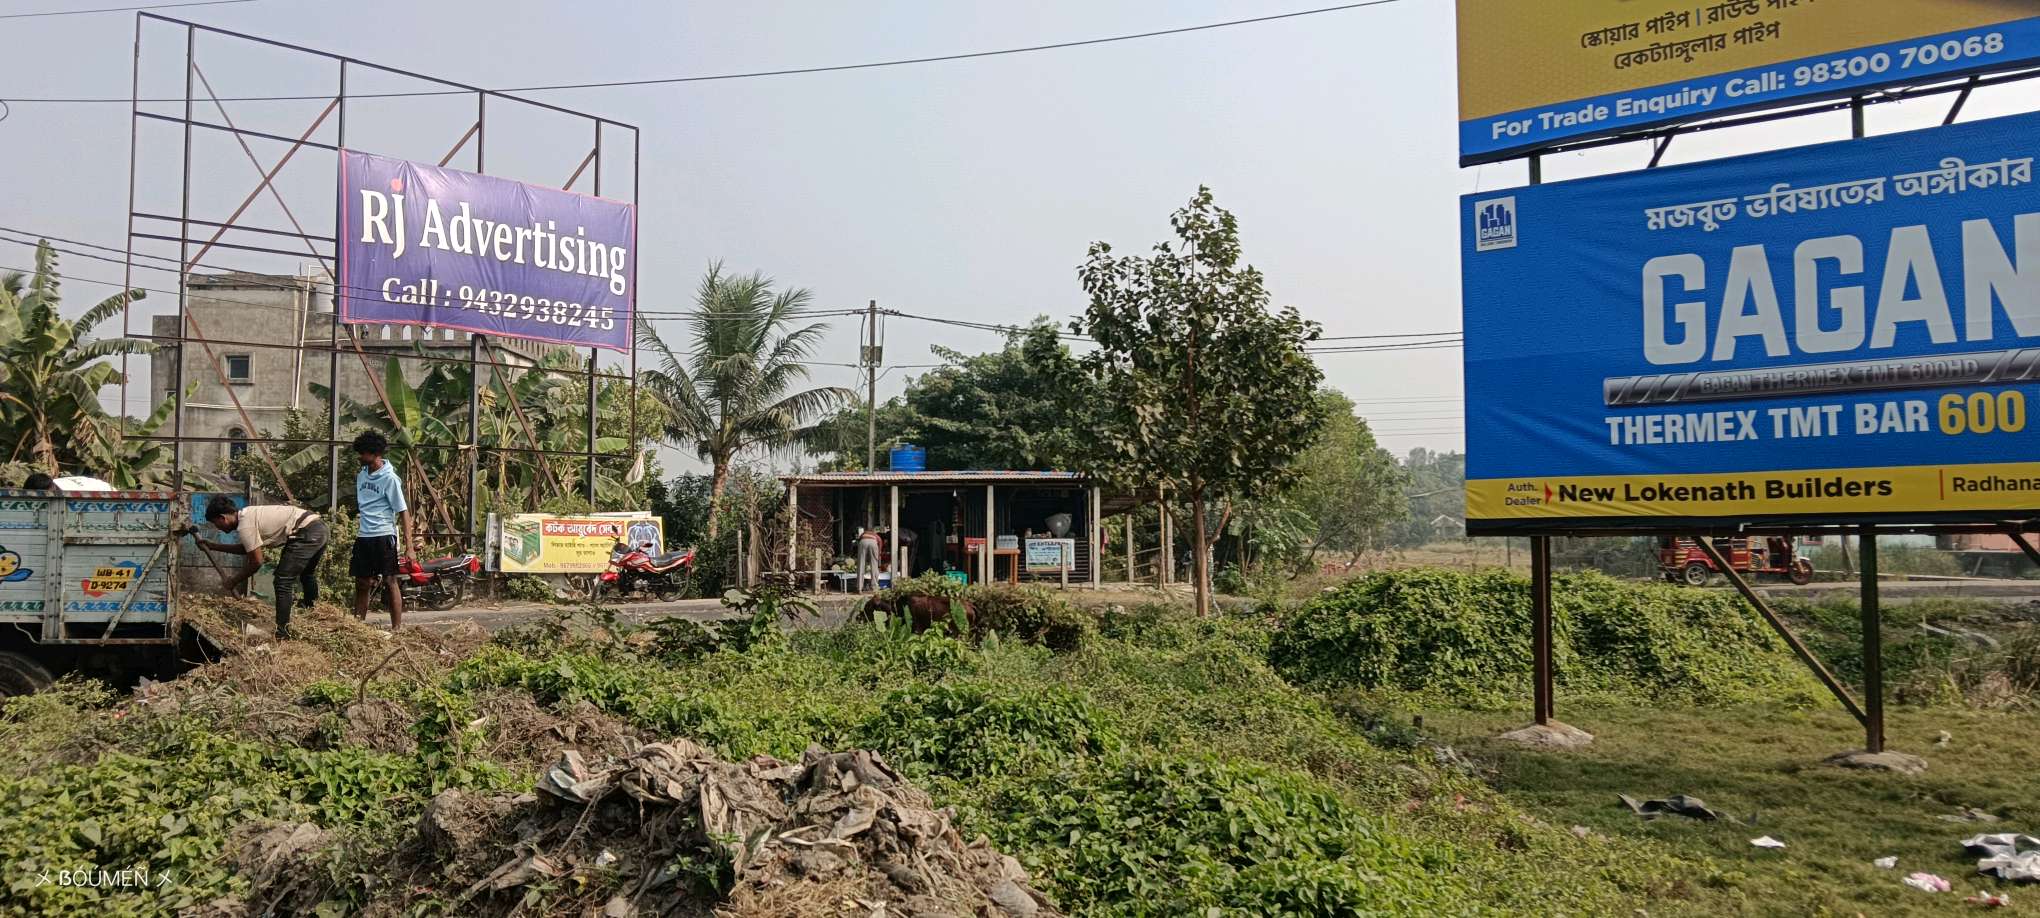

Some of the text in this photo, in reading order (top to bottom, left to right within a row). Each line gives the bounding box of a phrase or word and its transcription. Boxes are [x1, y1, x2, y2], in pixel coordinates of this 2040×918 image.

[1580, 22, 1640, 49] স্কোয়ার
[1645, 10, 1690, 36] পাইপ
[1733, 20, 1781, 45] পাইপ
[1492, 32, 2004, 140] For Trade Enquiry Call: 98300 70068
[1645, 157, 2033, 232] মজবুত ভবিষ্যতের অঙ্গীকার
[419, 198, 627, 296] Advertising
[1481, 225, 1512, 239] GAGAN
[382, 278, 437, 306] Call
[459, 285, 615, 331] 9432938245
[1642, 211, 2040, 366] GAGAN
[1700, 358, 1978, 394] GAGAN THERMEX TMT 600HD
[1605, 390, 2026, 446] THERMEX TMT BAR 600
[1504, 496, 1542, 507] Dealer
[1507, 482, 1539, 493] Auth.
[1559, 477, 1893, 503] New Lokenath Builders
